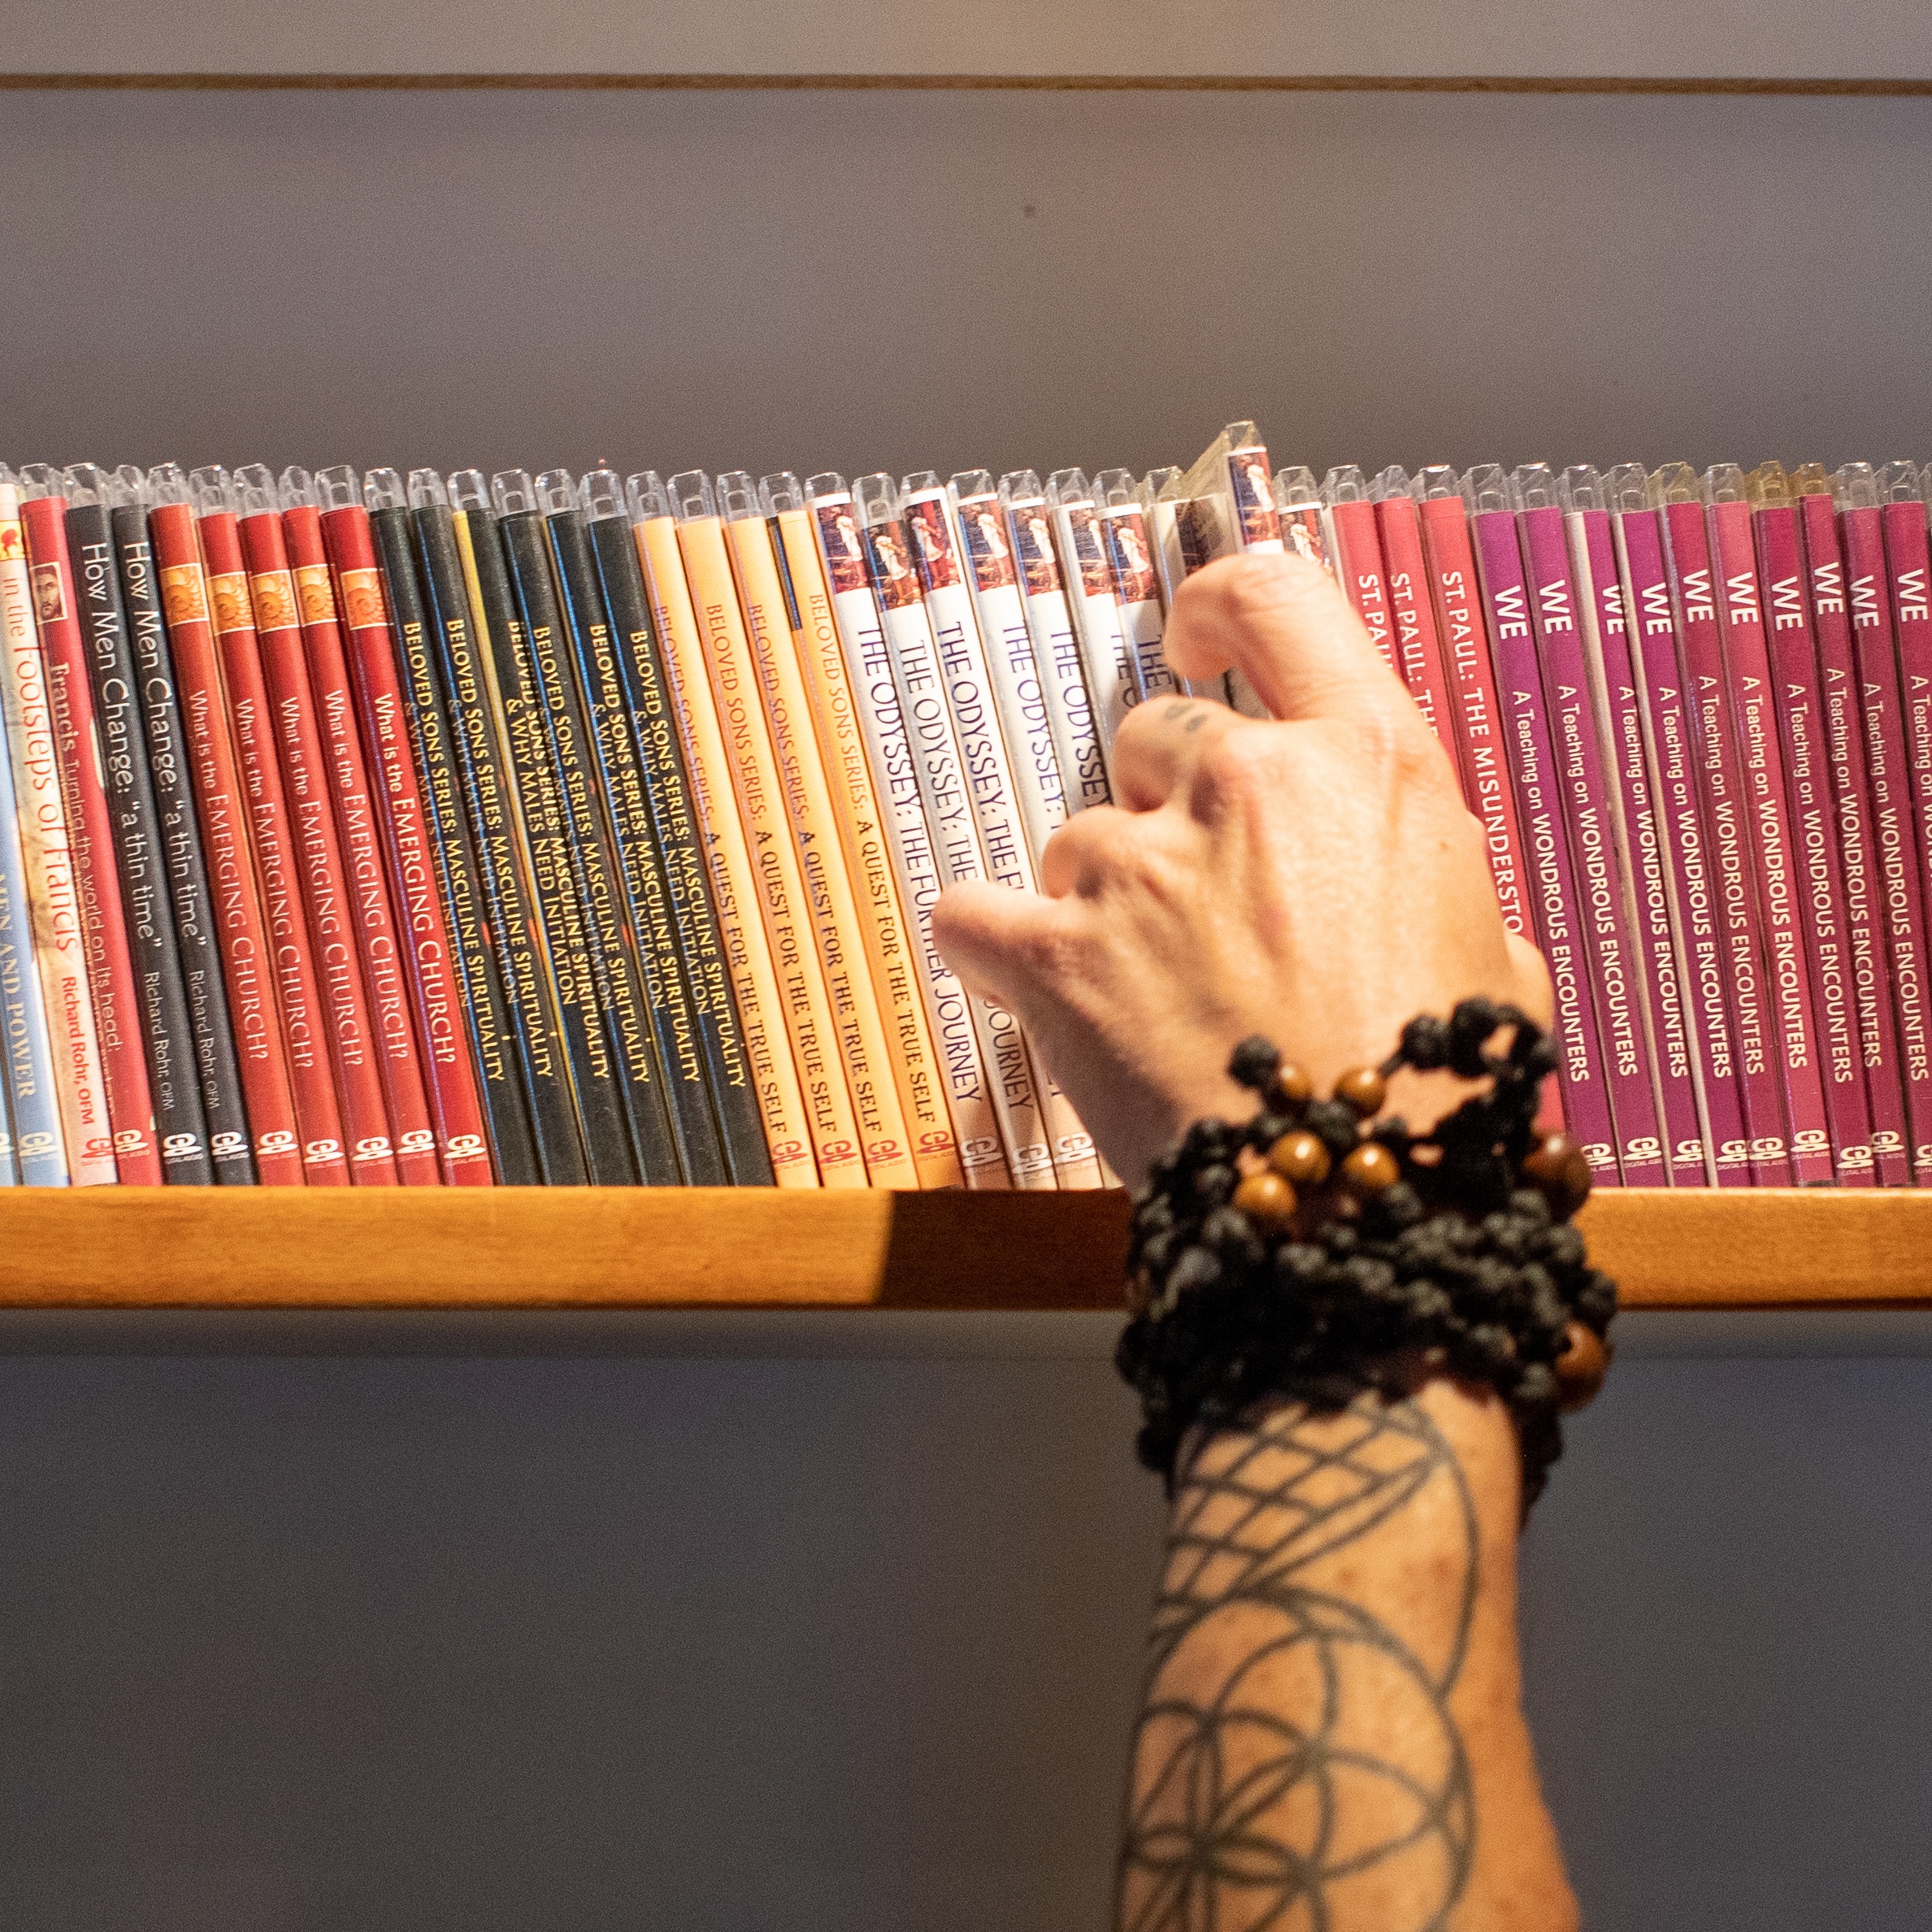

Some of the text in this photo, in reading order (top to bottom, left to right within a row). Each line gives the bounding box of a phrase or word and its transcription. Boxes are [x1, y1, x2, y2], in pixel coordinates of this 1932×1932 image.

[2, 578, 19, 596] in
[81, 542, 109, 600] How
[123, 541, 151, 599] How
[1390, 573, 1413, 605] ST.
[1442, 571, 1465, 603] ST.
[1682, 569, 1713, 623] WE
[1726, 571, 1758, 625] WE
[1771, 575, 1804, 630] WE
[7, 605, 28, 636] the
[91, 611, 119, 670] Men
[133, 610, 161, 669] Men
[1495, 585, 1527, 639] WE
[1539, 580, 1573, 634] WE
[1641, 584, 1673, 635] WE
[857, 627, 889, 676] THE
[898, 639, 934, 694] THE
[936, 621, 972, 677] THE
[1396, 610, 1426, 681] PAUL:
[1448, 608, 1477, 680] PAUL:
[50, 662, 79, 751] Francis
[102, 678, 133, 793] Change:
[145, 677, 177, 792] Change:
[1002, 619, 1070, 813] THE ODYSSEY:
[1463, 687, 1489, 737] THE
[870, 681, 923, 817] ODYSSEY:
[913, 697, 966, 831] ODYSSEY:
[951, 680, 1006, 815] ODYSSEY:
[37, 803, 66, 831] of
[73, 834, 92, 868] the
[403, 622, 504, 1080] BELOVED SONS SERIES: MASCULINE SPIRITUALITY
[446, 619, 553, 1076] BELOVED SONS SERIES: MASCULINE SPIRITUALITY
[506, 698, 577, 1005] & WHY MALES NEED INITIATION
[589, 624, 700, 1081] BELOVED SONS SERIES: MASCULINE SPIRITUALITY
[899, 821, 929, 870] THE
[984, 818, 1018, 869] THE
[124, 833, 149, 879] thin
[168, 831, 193, 878] thin
[189, 689, 268, 1058] What is the EMERGING CHURCH?
[280, 696, 363, 1065] What is the EMERGING CHURCH?
[374, 692, 455, 1062] What is the EMERGING CHURCH?
[629, 630, 745, 1087] BELOVED SONS SERIES: MASCULINE SPIRITUALITY
[706, 603, 836, 1132] BELOVED SONS SERIES: A QUEST FOR THE TRUE SELF
[808, 588, 936, 1122] BELOVED SONS SERIES: A QUEST FOR THE TRUE SELF
[945, 834, 978, 882] THE
[1512, 691, 1589, 1082] A Teaching on WONDROUS ENCOUNTERS
[1557, 685, 1638, 1075] A Teaching on WONDROUS ENCOUNTERS
[1658, 687, 1731, 1078] A Teaching on WONDROUS ENCOUNTERS
[1698, 675, 1765, 1075] A Teaching on WONDROUS ENCOUNTERS
[1742, 676, 1807, 1068] A Teaching on WONDROUS ENCOUNTERS
[1787, 684, 1853, 1083] A Teaching on WONDROUS ENCOUNTERS
[82, 875, 105, 929] world
[132, 885, 162, 947] time"
[176, 884, 206, 945] time"
[91, 936, 106, 962] on
[6, 1002, 36, 1099] POWER
[61, 976, 94, 1124] Richard Rohr, OFM
[143, 970, 167, 1035] Richard
[160, 1082, 175, 1110] OFM
[189, 970, 212, 1033] Richard
[206, 1080, 220, 1109] OFM
[934, 988, 983, 1101] JOURNEY
